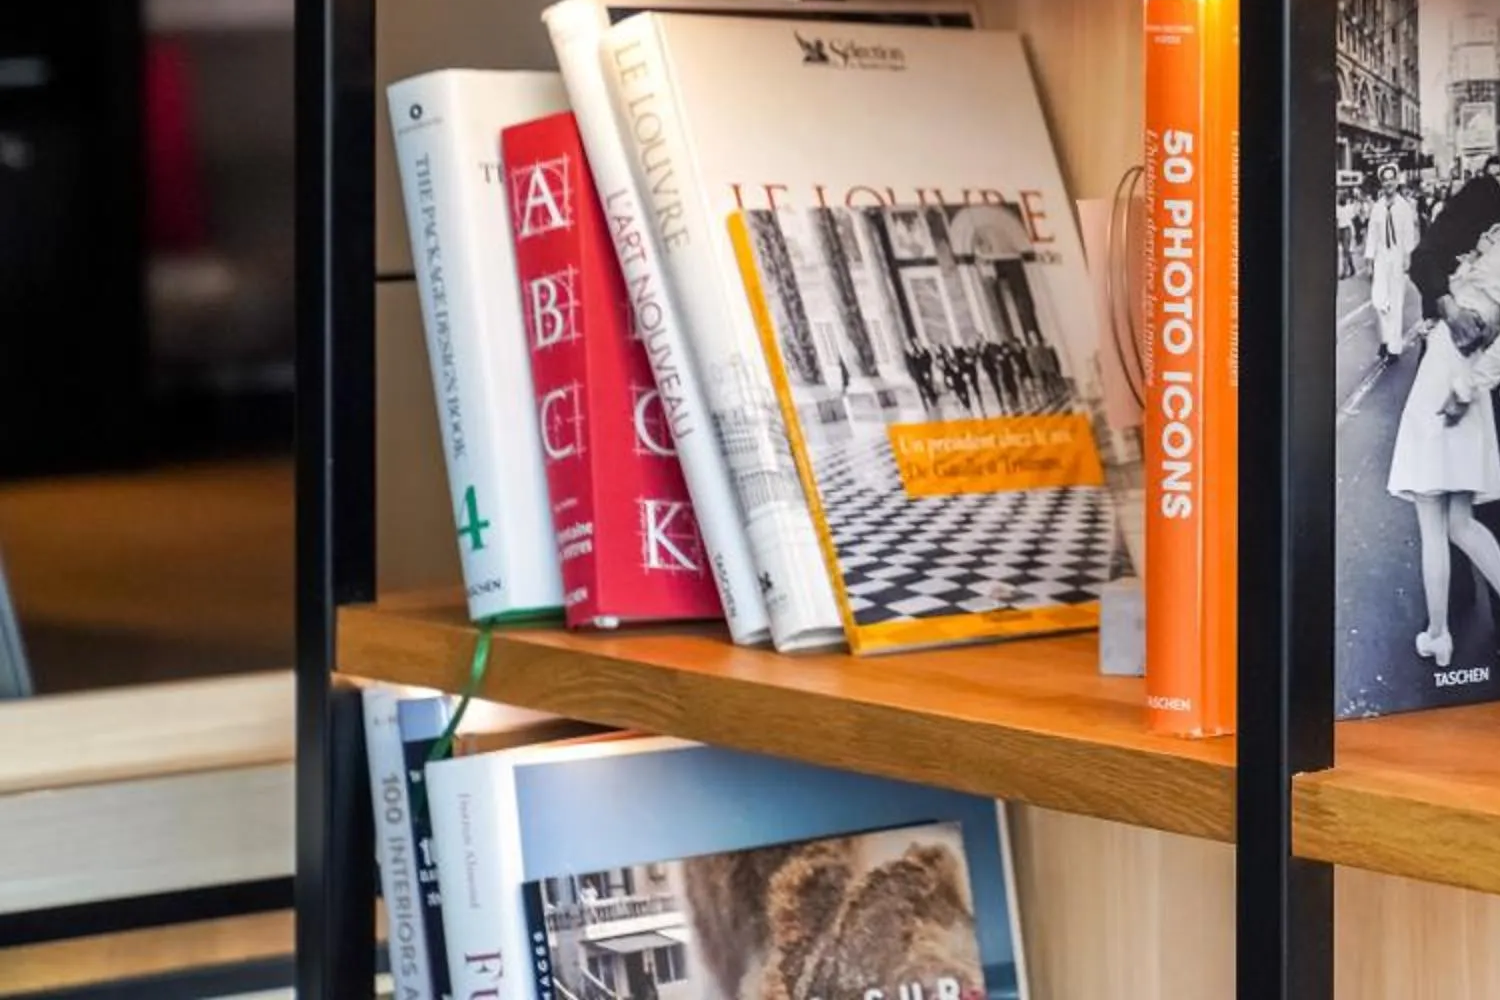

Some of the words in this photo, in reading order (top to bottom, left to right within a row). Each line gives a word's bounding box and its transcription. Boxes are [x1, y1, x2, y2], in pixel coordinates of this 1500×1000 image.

[615, 40, 649, 86] LE
[415, 152, 434, 201] THE
[628, 93, 691, 254] LOUVRE
[1162, 129, 1194, 184] 50
[520, 166, 567, 238] A
[531, 276, 565, 349] B
[1162, 200, 1194, 355] PHOTO
[606, 188, 648, 267] L'ART
[630, 272, 696, 440] NOUVEAU
[541, 389, 575, 460] C
[1160, 371, 1194, 521] ICONS
[457, 484, 490, 551] 4
[1434, 666, 1490, 687] TASCHEN
[381, 773, 405, 825] 100
[387, 835, 418, 978] INTERIORS
